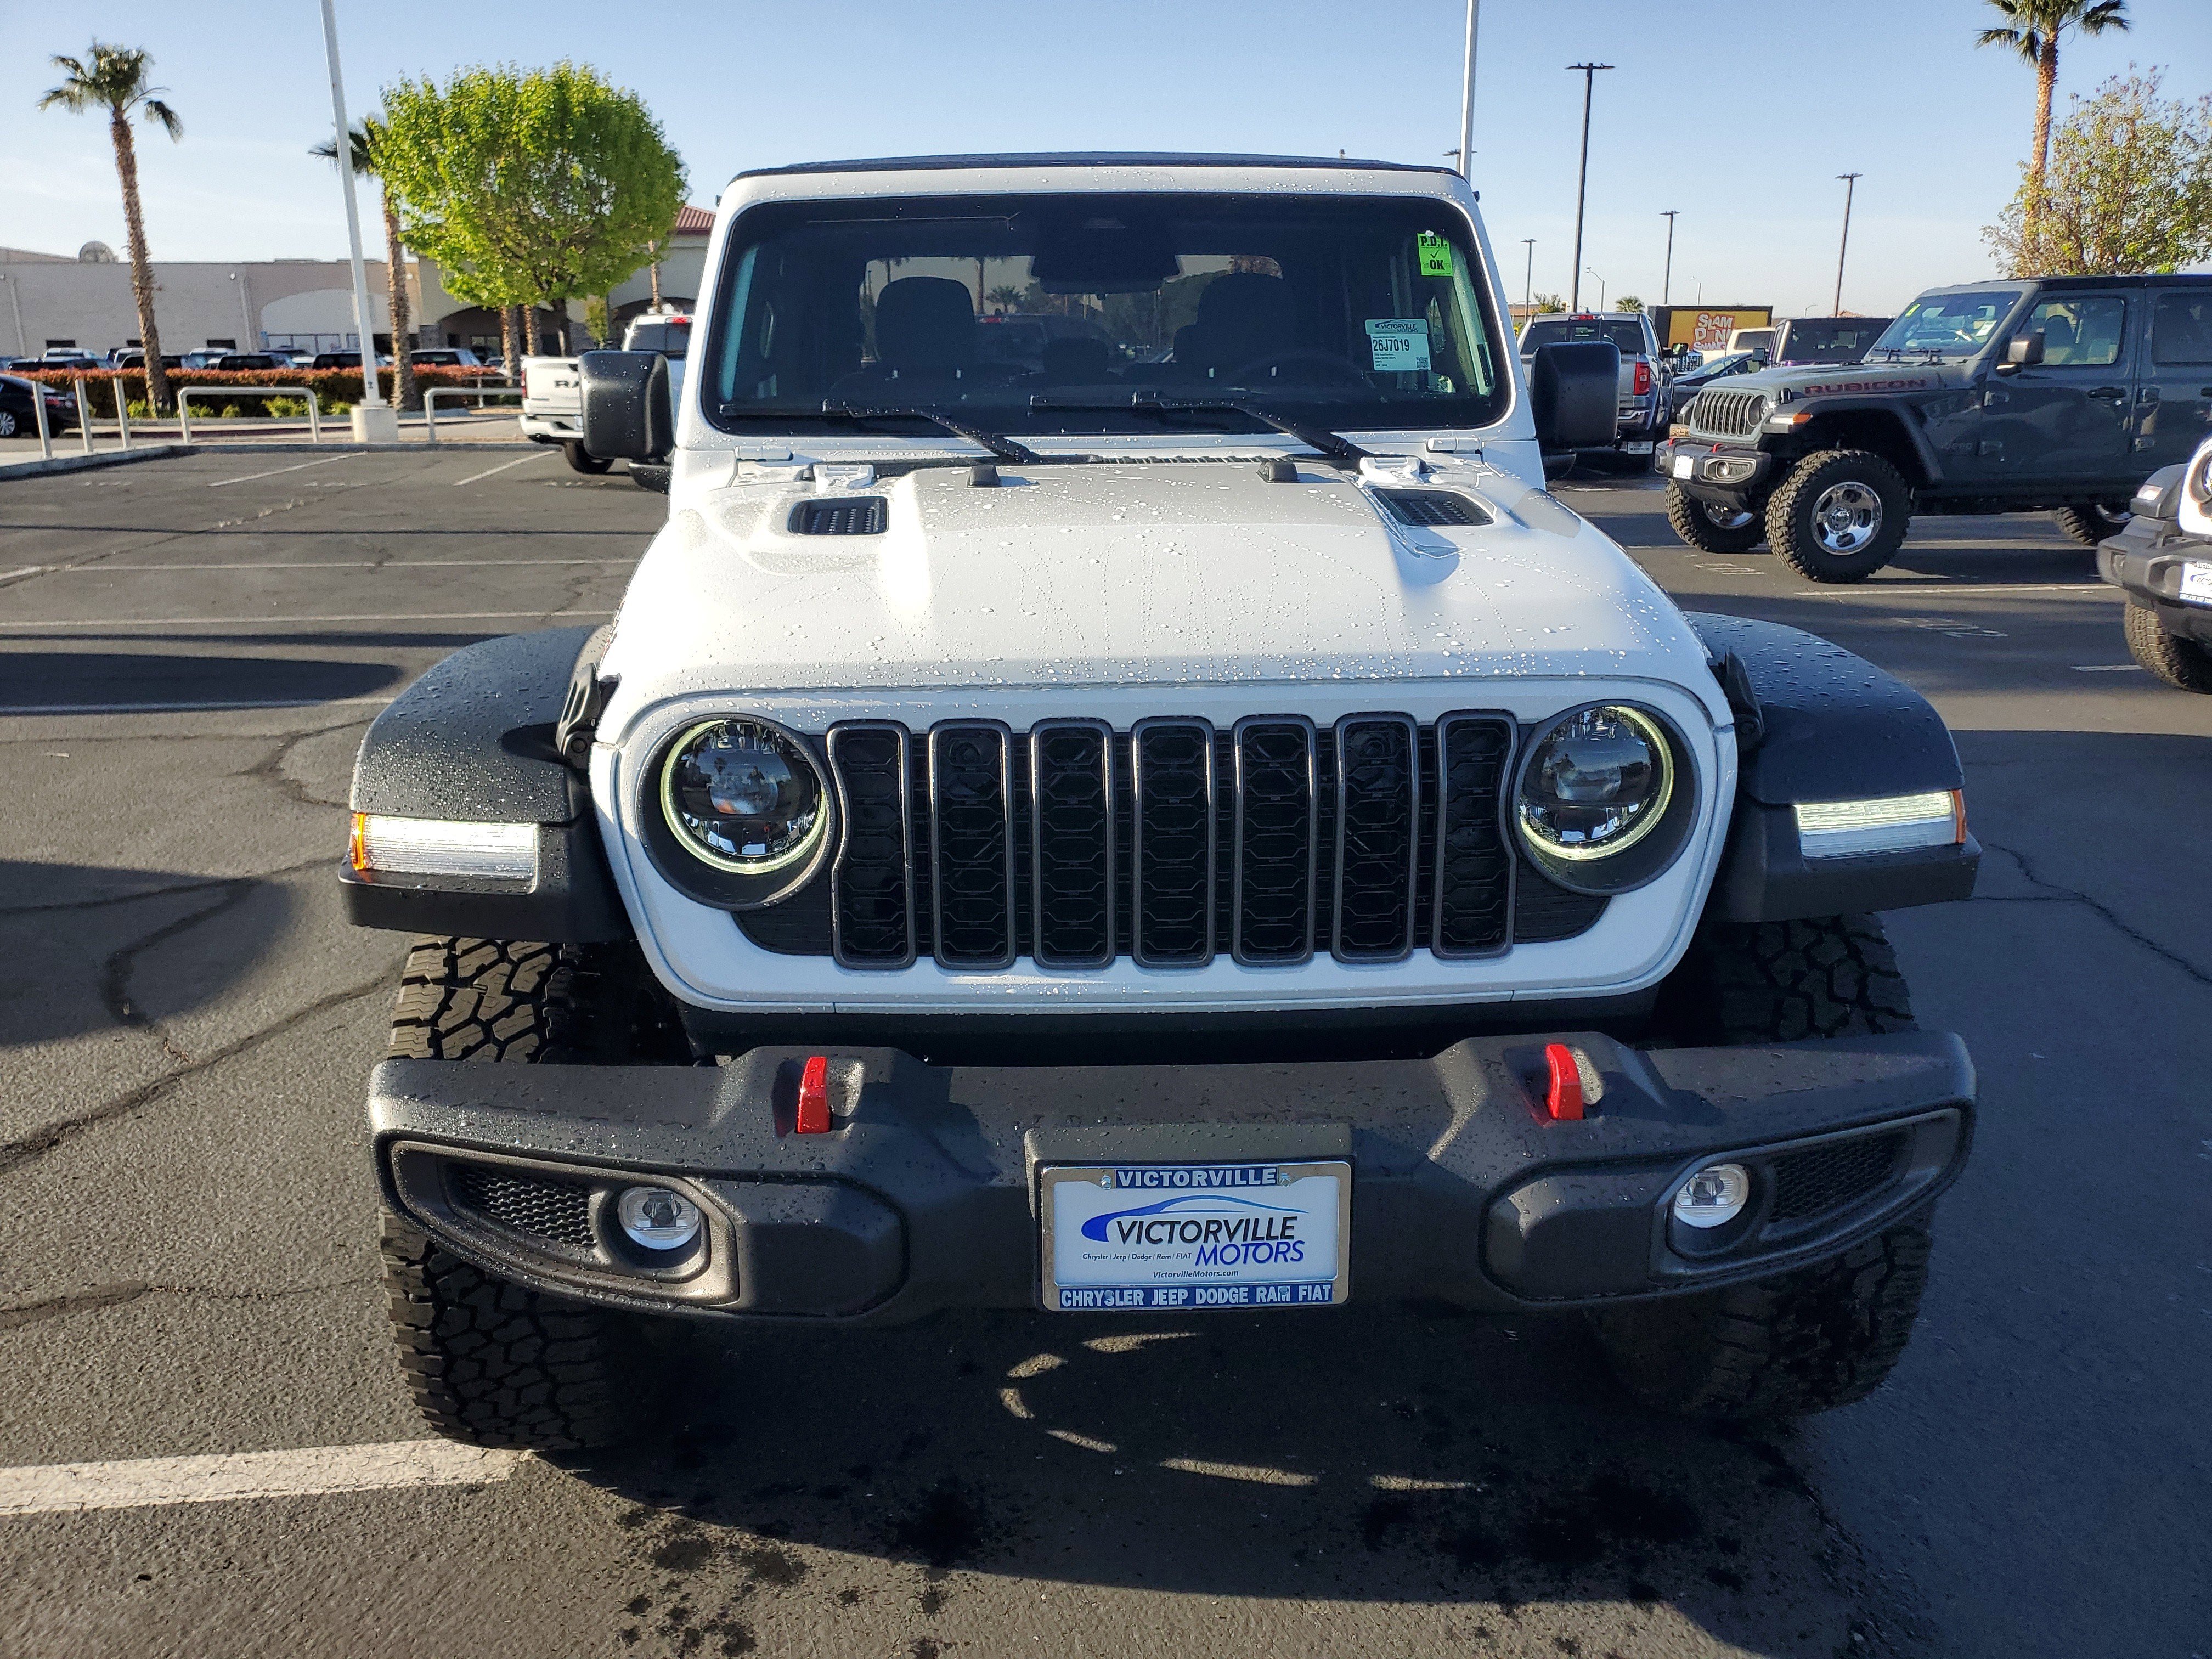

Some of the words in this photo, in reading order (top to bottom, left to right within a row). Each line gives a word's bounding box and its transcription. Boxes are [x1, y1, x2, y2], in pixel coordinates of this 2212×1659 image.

[1420, 236, 1448, 247] P.D.I.
[1429, 259, 1446, 270] OK
[1697, 314, 1733, 330] SLAM
[1372, 338, 1410, 352] 26J7019
[1804, 379, 1926, 395] RUBICON
[1118, 1168, 1276, 1187] VICTORVILLE
[1116, 1216, 1297, 1244] VICTORVILLE
[1082, 1253, 1108, 1261] Chrysler
[1113, 1253, 1127, 1262] Jeep
[1131, 1253, 1152, 1261] Dodge
[1194, 1240, 1305, 1266] MOTORS
[1061, 1289, 1144, 1307] CHRYSLER
[1151, 1289, 1188, 1306] JEEP
[1195, 1287, 1249, 1304] DODGE
[1256, 1285, 1290, 1302] RAM
[1299, 1284, 1331, 1301] FIAT
